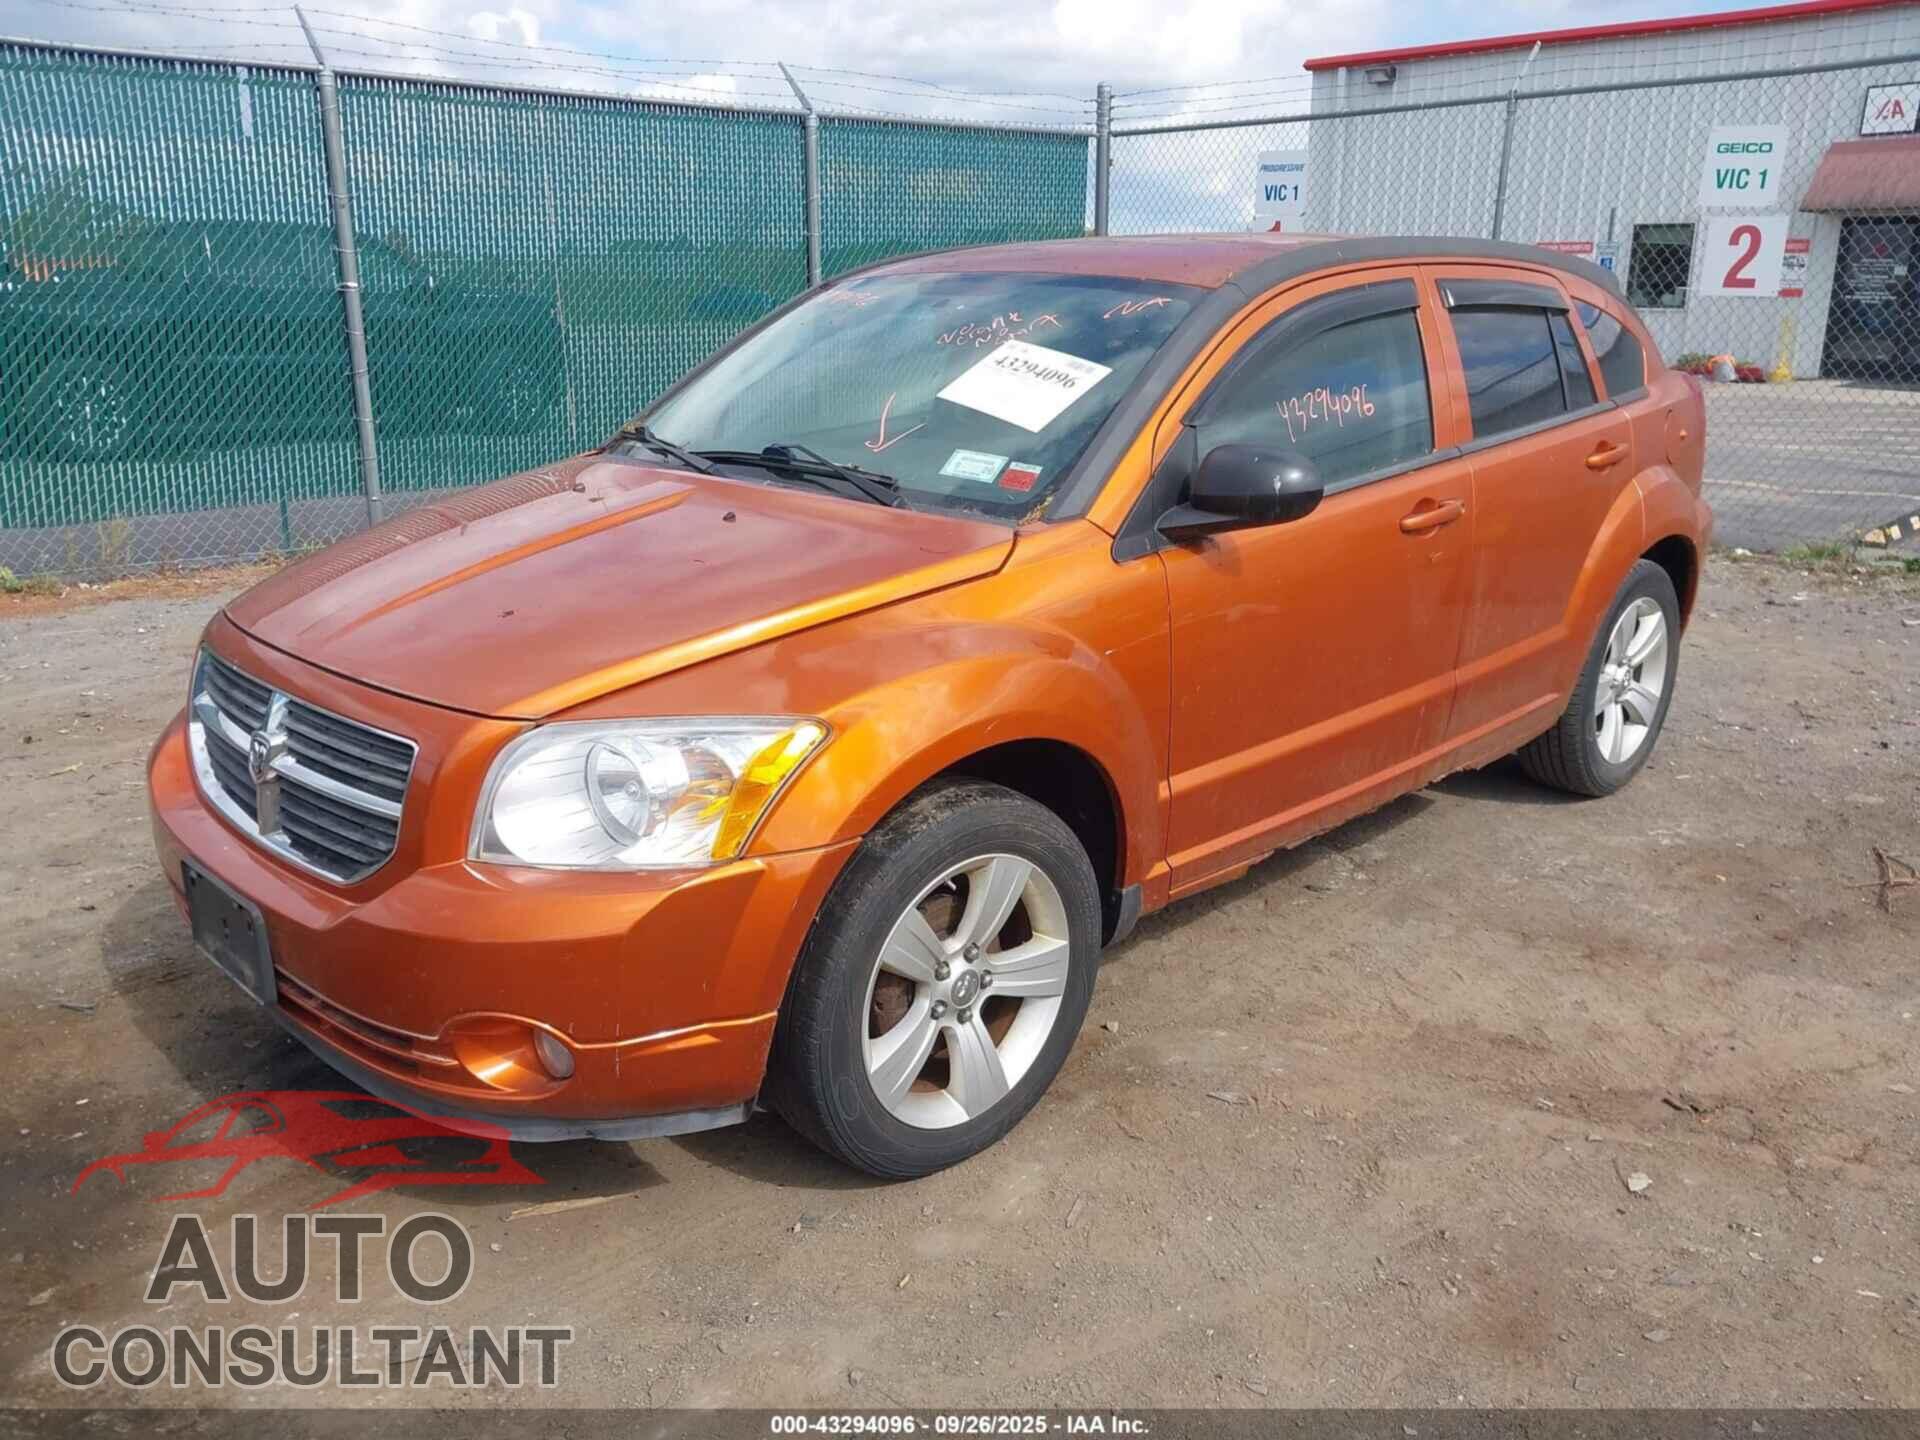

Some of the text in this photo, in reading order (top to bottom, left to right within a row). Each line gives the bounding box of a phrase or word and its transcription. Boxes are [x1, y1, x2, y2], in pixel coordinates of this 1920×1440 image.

[1716, 142, 1774, 154] GEICO
[1264, 183, 1299, 201] VIC 1
[1715, 168, 1769, 190] VIC 1
[1722, 224, 1763, 289] 2
[995, 356, 1077, 389] 43294096
[1276, 384, 1375, 443] 43294096
